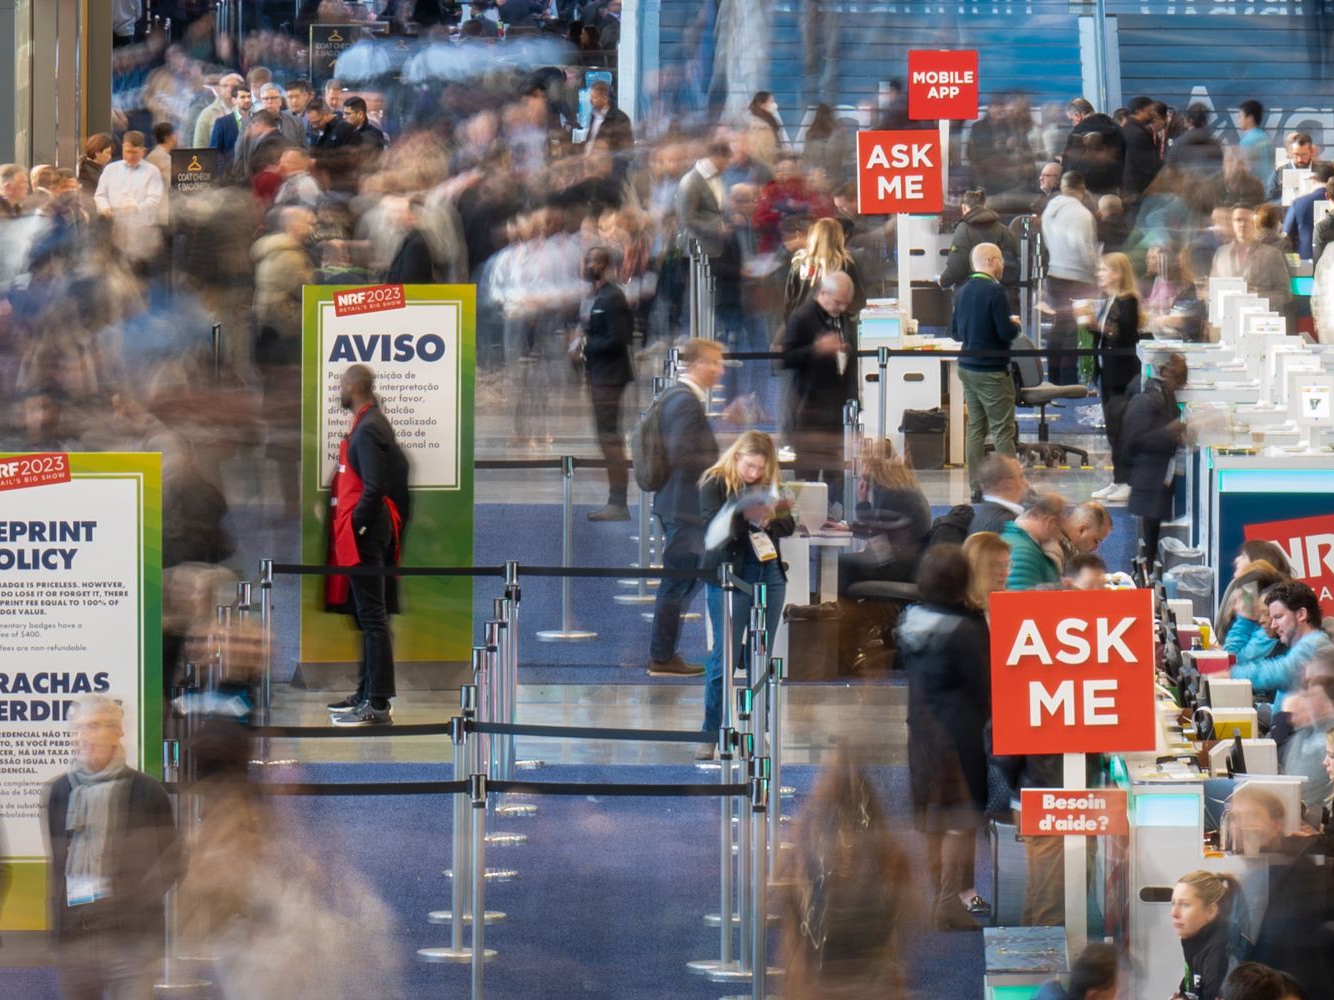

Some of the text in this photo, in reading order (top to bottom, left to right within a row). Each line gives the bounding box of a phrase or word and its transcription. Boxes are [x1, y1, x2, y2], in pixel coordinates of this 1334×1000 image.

[913, 71, 974, 84] MOBILE
[927, 87, 960, 99] APP
[866, 143, 933, 169] ASK
[877, 175, 924, 200] ME
[328, 334, 446, 363] AVISO
[379, 383, 439, 393] interpretação
[399, 395, 425, 404] favor,
[390, 418, 437, 426] localizado
[24, 475, 39, 484] BIG
[41, 472, 66, 481] SHOW
[82, 581, 126, 589] HOWEVER,
[29, 622, 56, 630] badges
[1006, 617, 1139, 666] ASK
[1029, 679, 1118, 727] ME
[42, 730, 61, 738] NÃO
[26, 739, 47, 747] VOCÊ
[1043, 794, 1106, 809] Besoin
[1039, 815, 1109, 831] d'aide?
